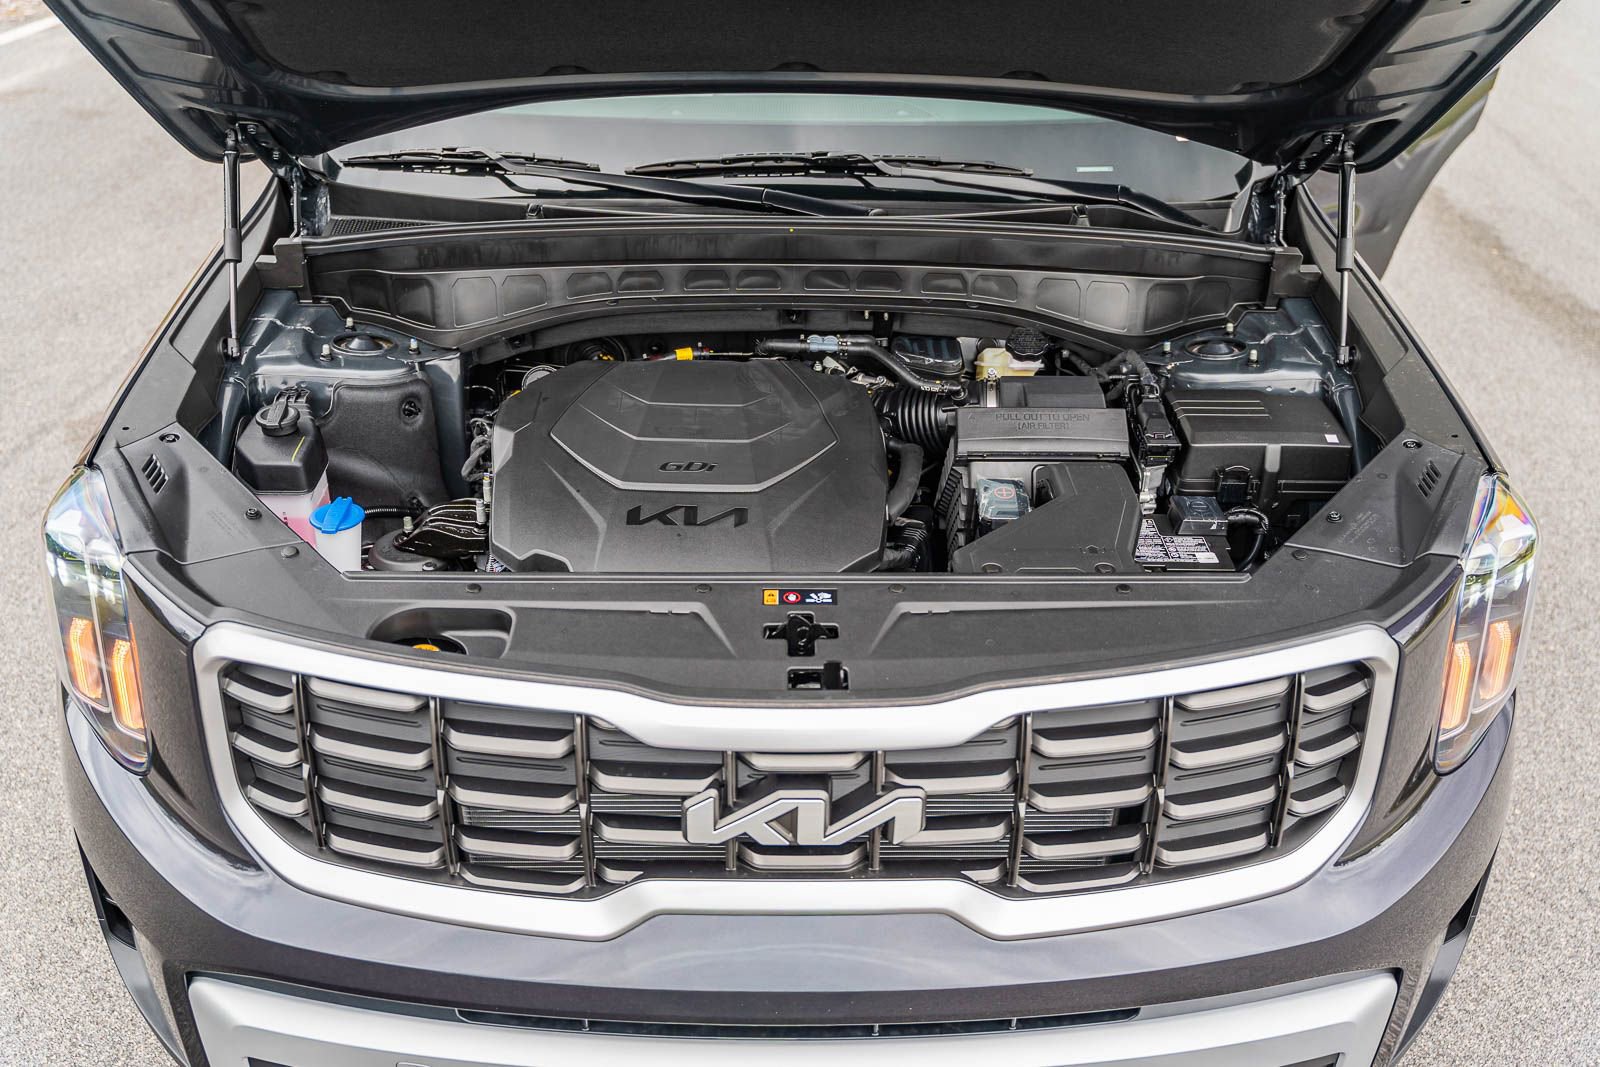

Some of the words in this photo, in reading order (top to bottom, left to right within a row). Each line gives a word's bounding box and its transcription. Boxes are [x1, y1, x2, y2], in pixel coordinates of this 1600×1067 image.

[996, 413, 1021, 421] PULL
[1023, 413, 1045, 421] OUT
[1047, 413, 1060, 421] TO
[1063, 413, 1090, 421] OPEN
[626, 504, 748, 528] KIA
[683, 789, 925, 845] KIA
